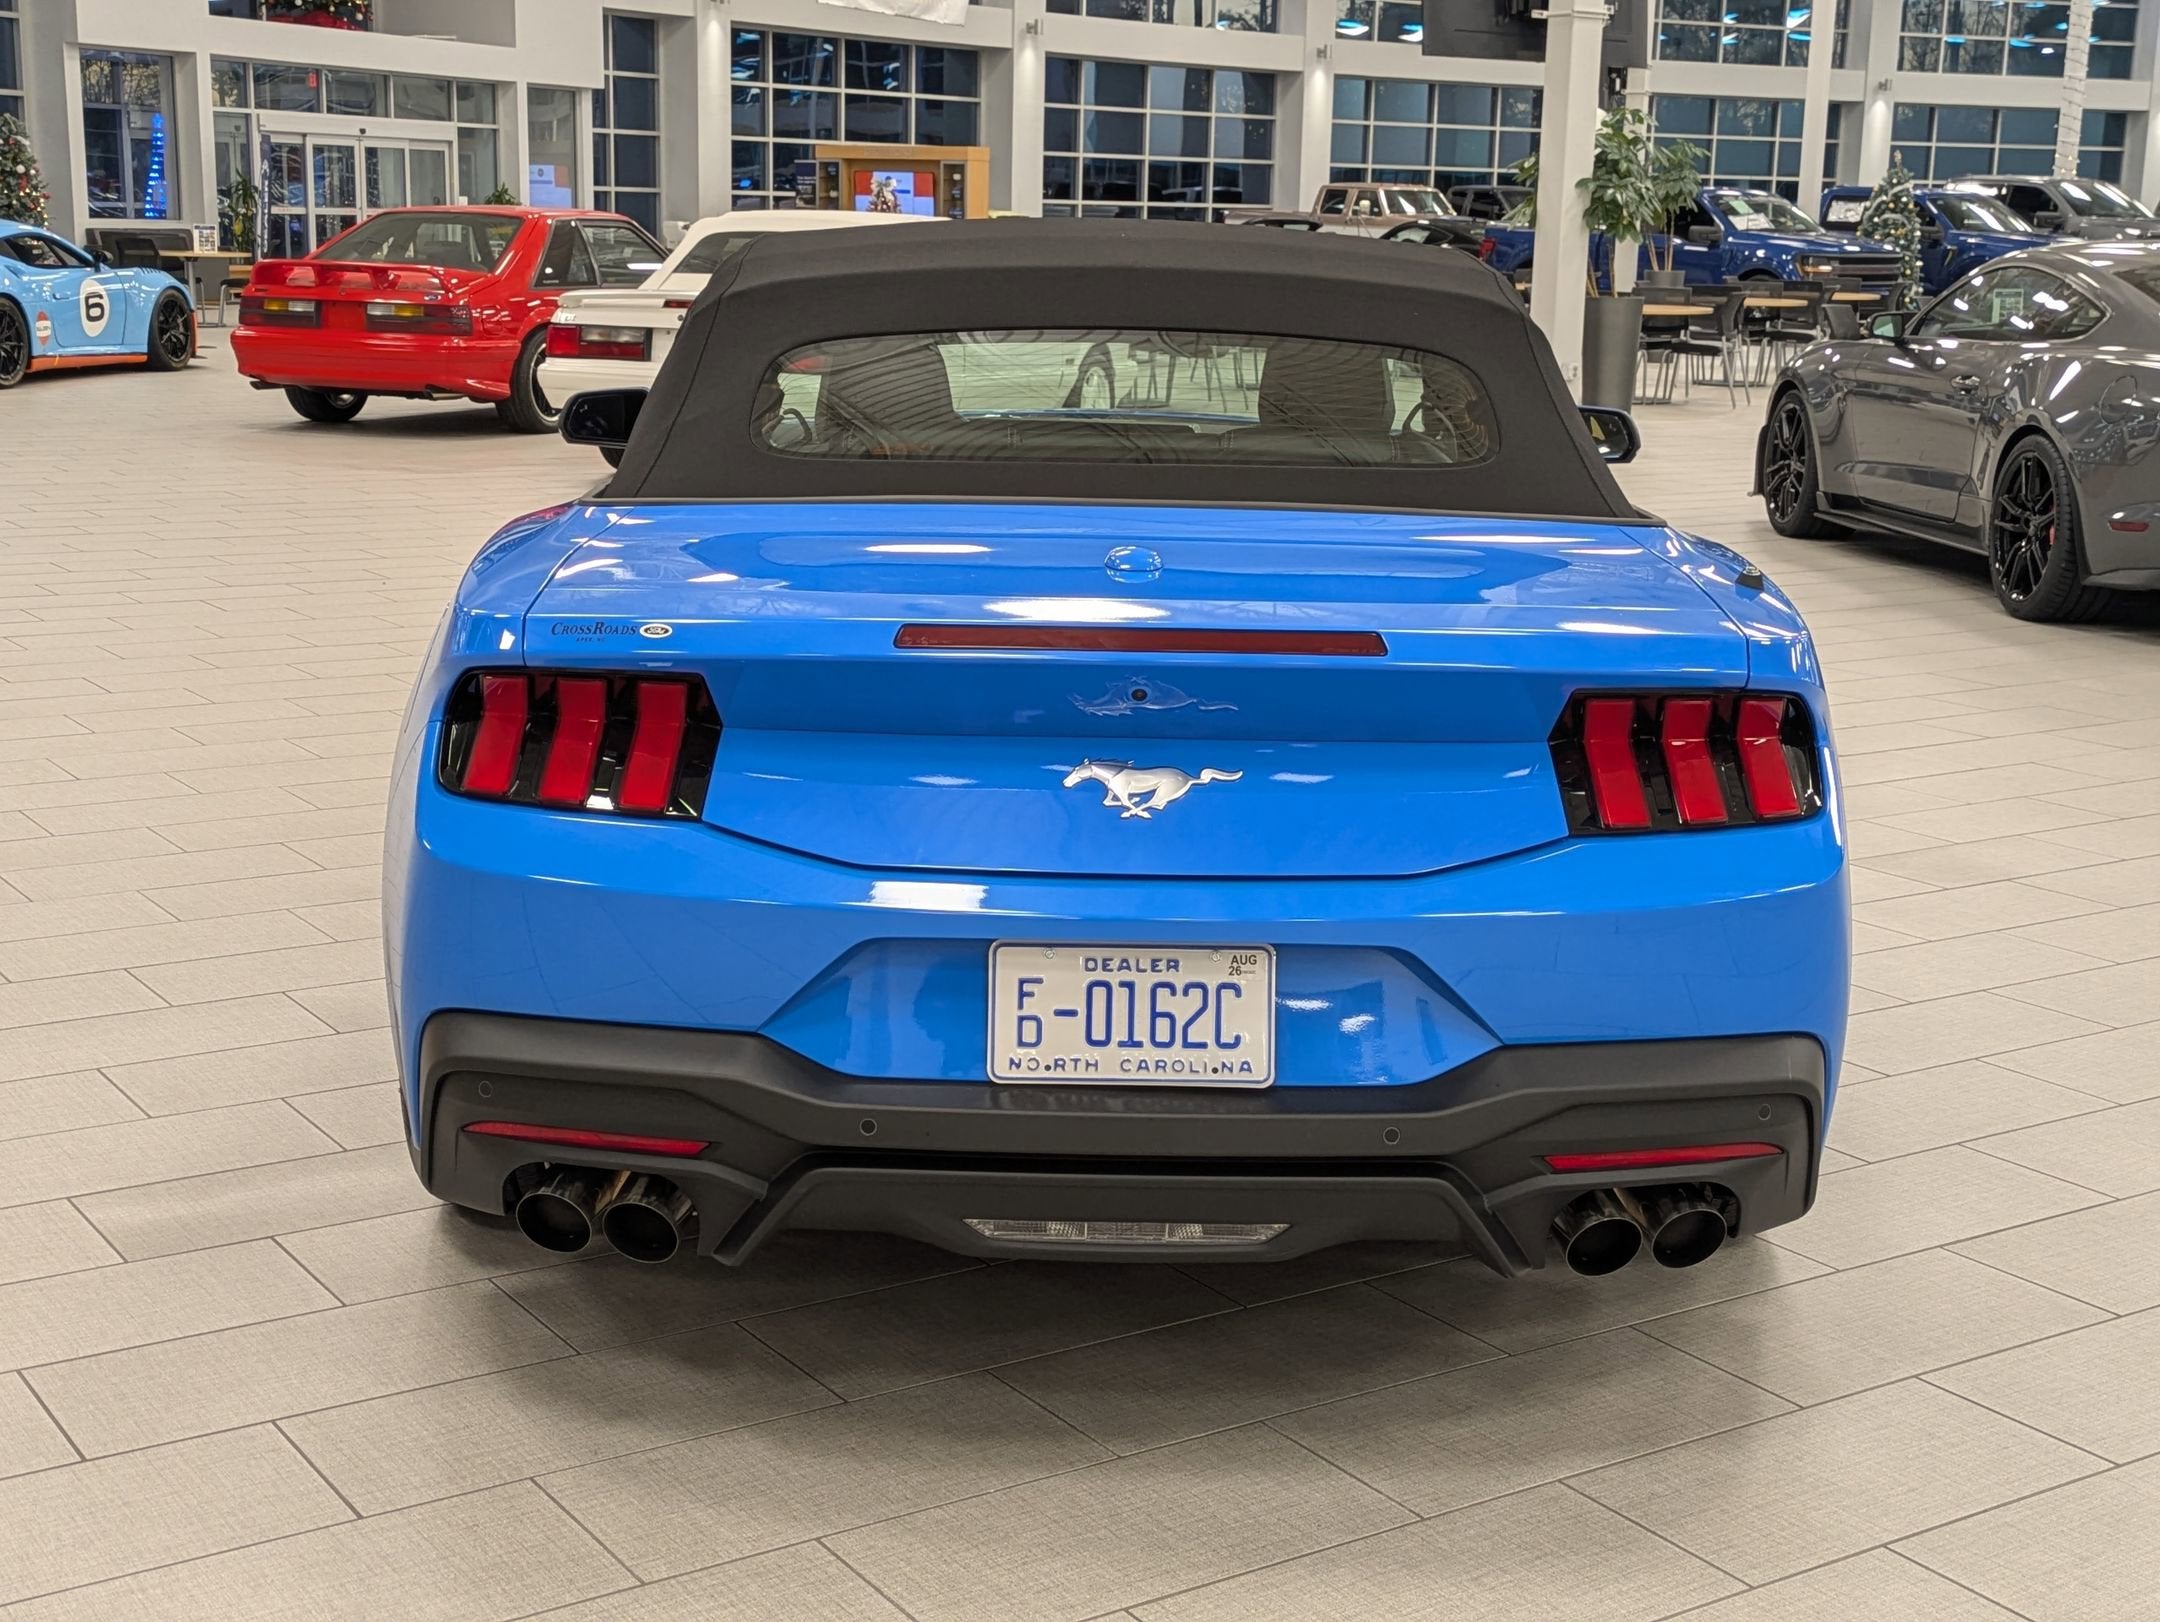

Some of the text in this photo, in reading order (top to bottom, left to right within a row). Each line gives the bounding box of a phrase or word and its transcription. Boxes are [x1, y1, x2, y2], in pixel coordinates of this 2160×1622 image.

[84, 291, 105, 322] 6
[1083, 957, 1181, 973] DEALER
[1230, 954, 1258, 966] AUG
[1228, 965, 1242, 976] 26
[1008, 1057, 1254, 1074] NORTH CAROLINA
